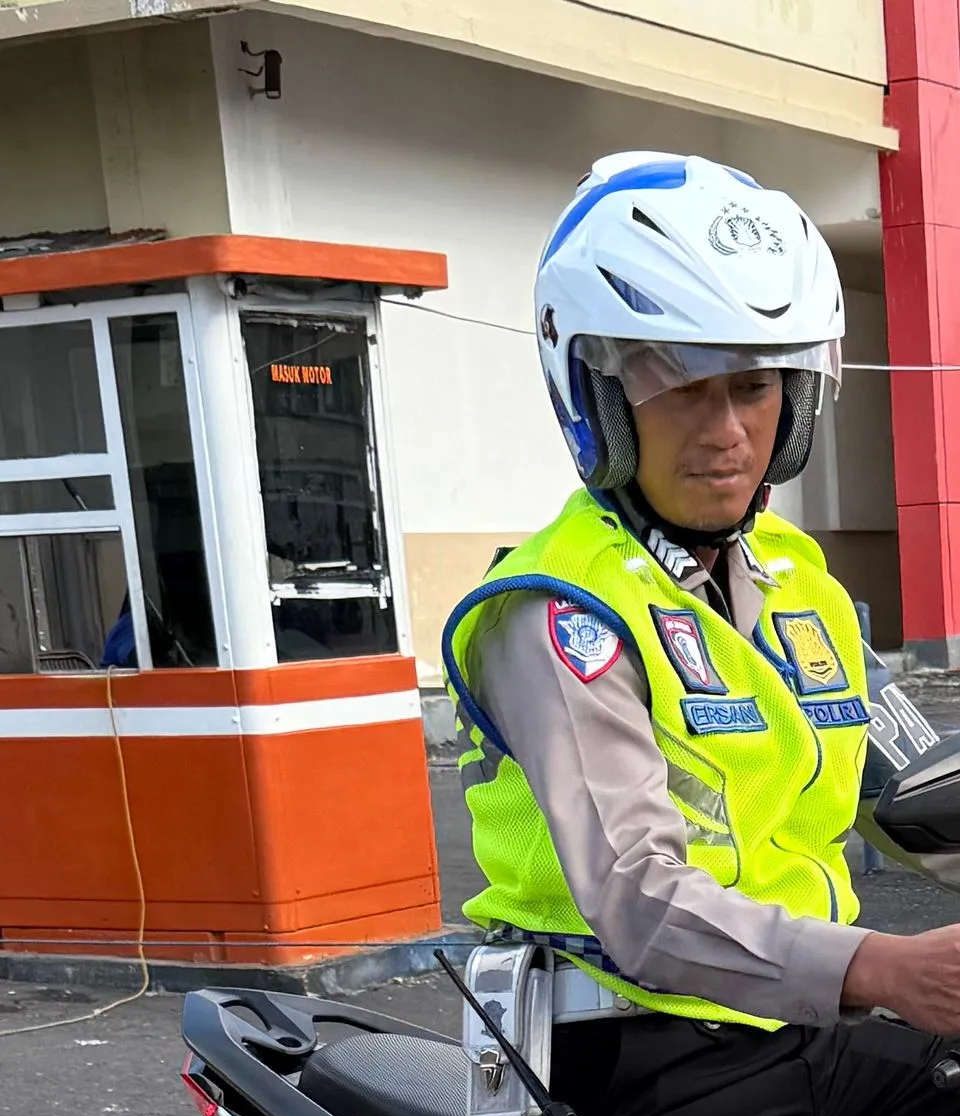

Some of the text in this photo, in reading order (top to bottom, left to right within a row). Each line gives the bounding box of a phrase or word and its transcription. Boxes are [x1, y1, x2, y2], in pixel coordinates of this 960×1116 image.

[271, 364, 332, 384] MASUK MOTOR
[803, 702, 868, 722] POLRI
